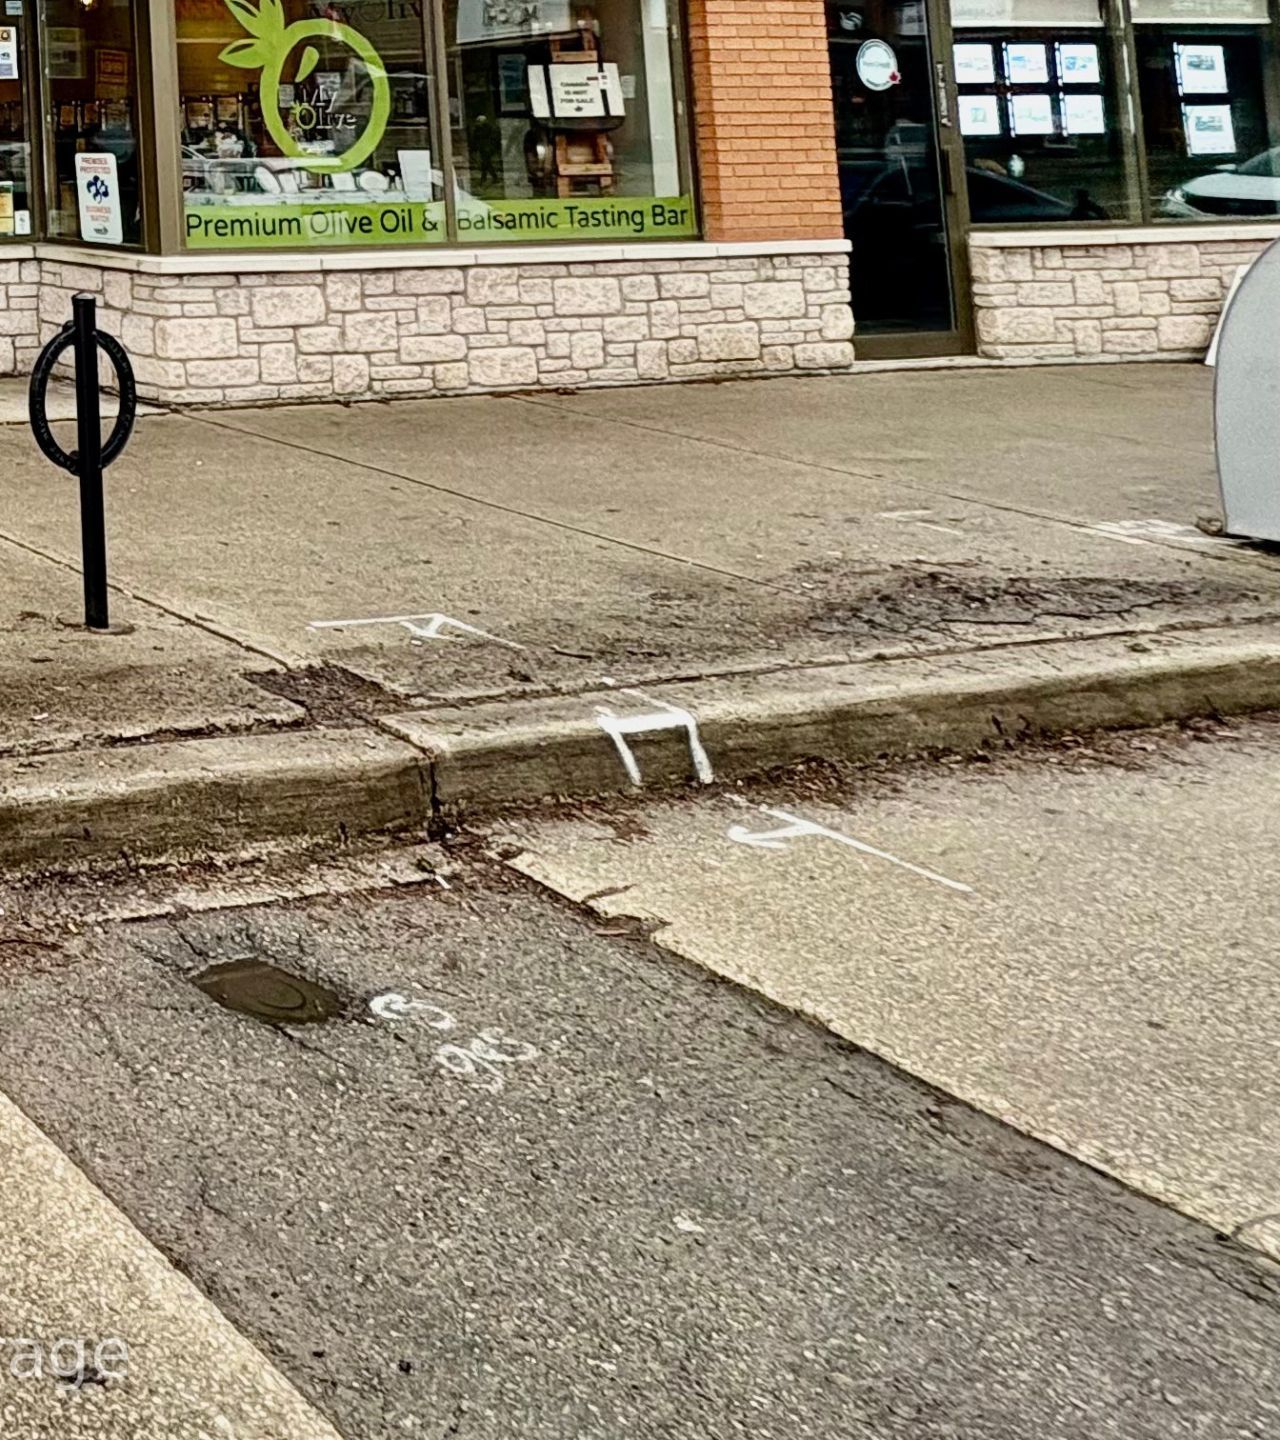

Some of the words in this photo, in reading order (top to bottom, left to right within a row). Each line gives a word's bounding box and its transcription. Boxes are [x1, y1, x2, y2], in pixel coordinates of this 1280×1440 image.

[186, 213, 302, 238] Premium
[309, 210, 373, 235] Olive
[380, 208, 414, 233] Oil
[421, 209, 439, 232] &
[457, 206, 558, 232] Balsamic
[563, 204, 646, 234] Tasting
[652, 203, 689, 227] Bar
